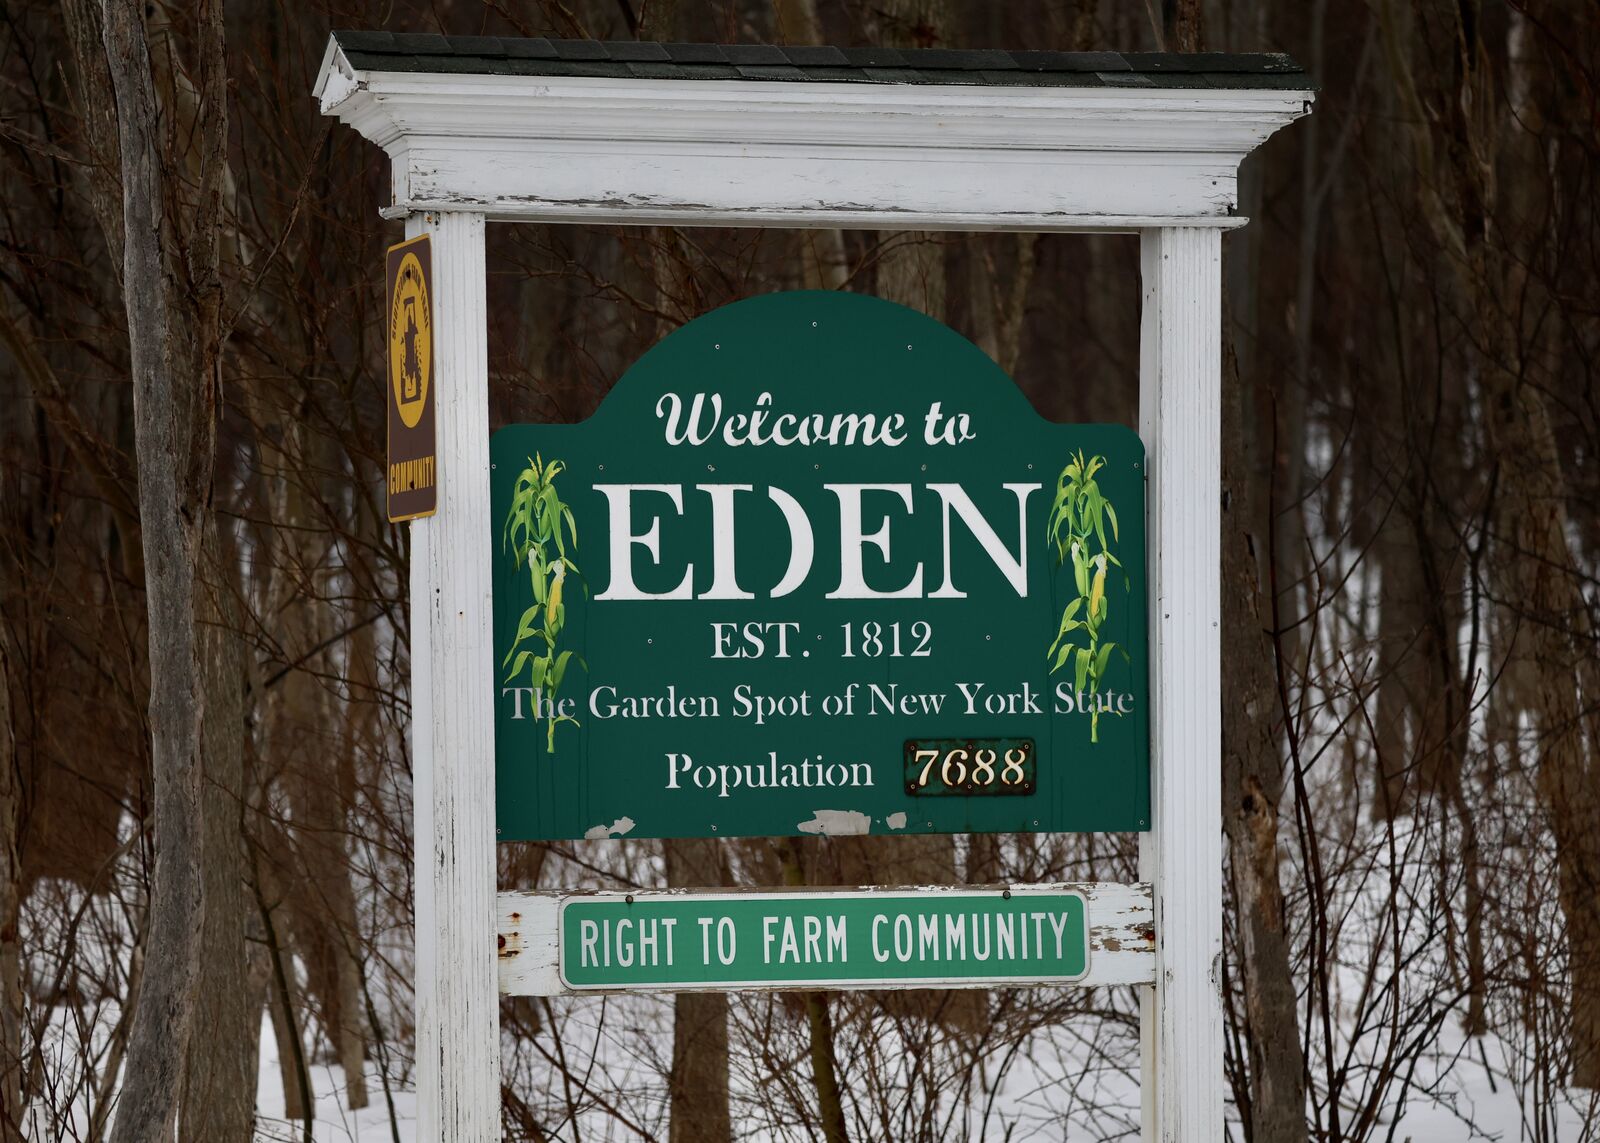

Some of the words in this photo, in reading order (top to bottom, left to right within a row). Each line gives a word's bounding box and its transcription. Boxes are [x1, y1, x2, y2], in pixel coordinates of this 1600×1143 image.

[655, 391, 908, 447] Welcome
[924, 401, 977, 446] to
[390, 455, 434, 495] COMMUNITY
[592, 483, 1043, 601] EDEN
[710, 622, 810, 660] EST.
[840, 621, 932, 658] 1812
[502, 687, 576, 719] The
[589, 685, 720, 719] Garden
[733, 684, 812, 725] Spot
[822, 683, 860, 716] of
[867, 683, 946, 716] New
[956, 682, 1043, 715] York
[1054, 681, 1134, 714] State
[665, 751, 875, 797] Population
[914, 749, 1027, 787] 7688
[579, 918, 678, 968] RIGHT
[697, 917, 738, 966] TO
[763, 915, 849, 964] FARM
[871, 911, 1069, 963] COMMUNITY
